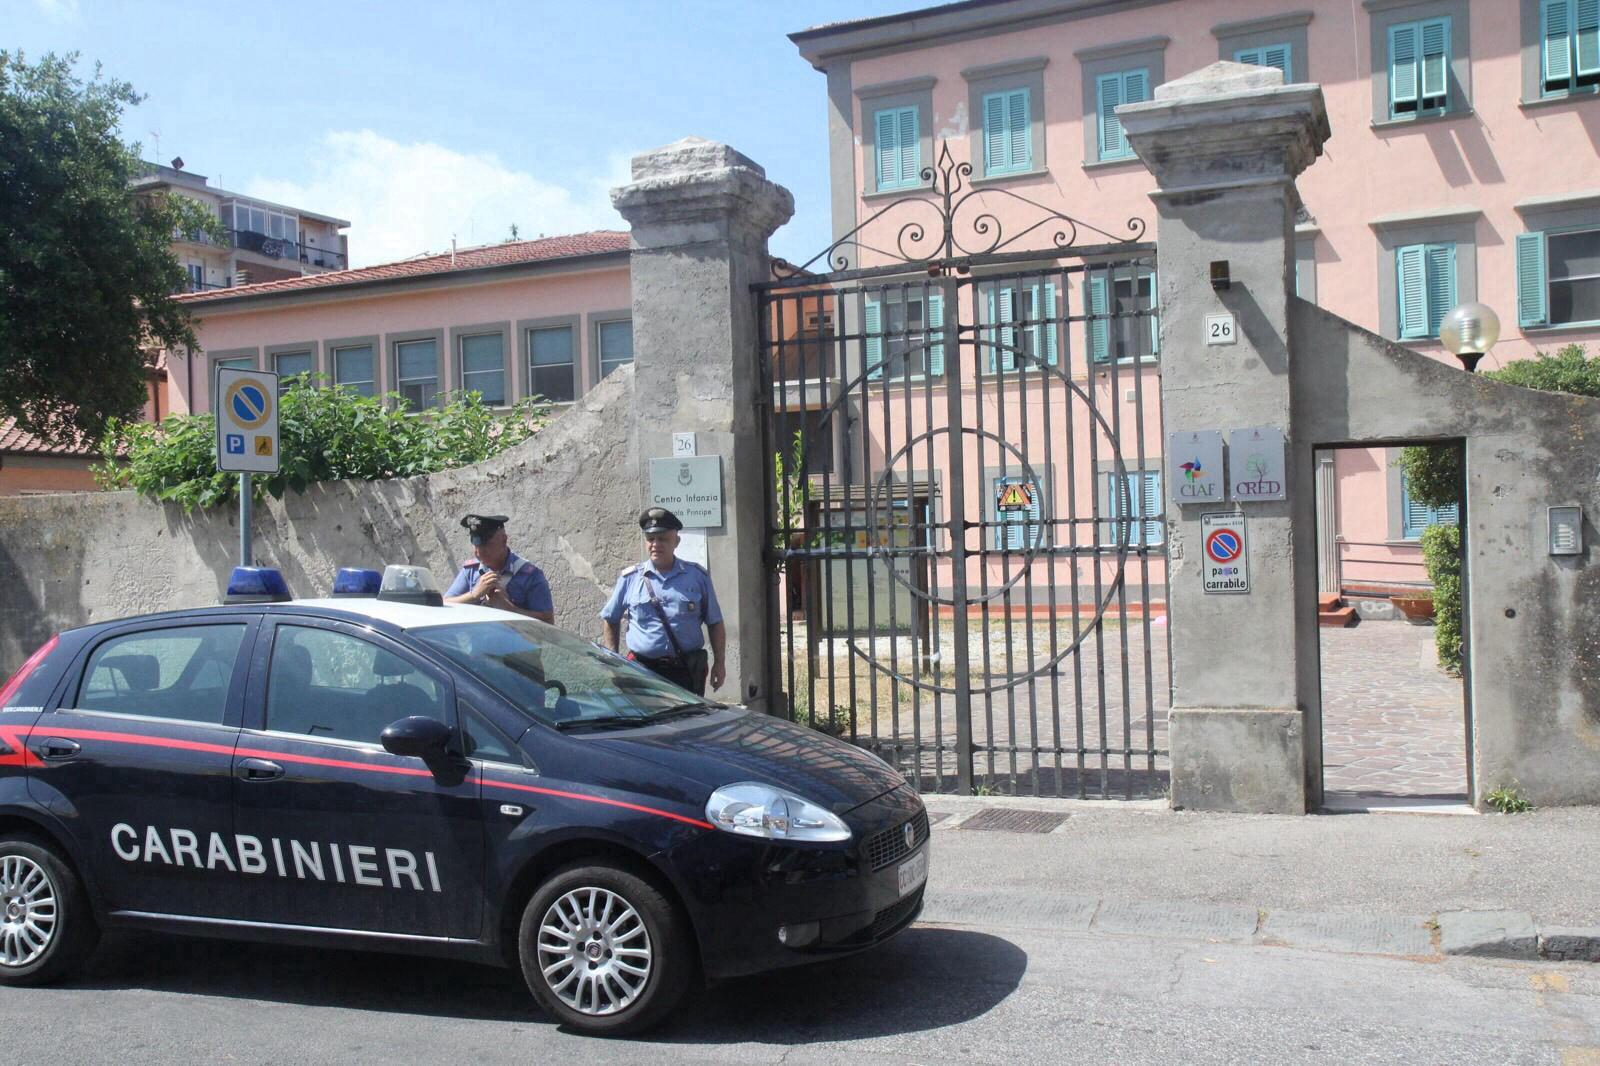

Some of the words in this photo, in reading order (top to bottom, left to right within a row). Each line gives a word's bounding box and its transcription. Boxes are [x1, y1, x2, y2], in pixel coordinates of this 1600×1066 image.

[1211, 321, 1231, 337] 26
[230, 437, 241, 452] P
[678, 439, 692, 451] 26
[1180, 483, 1215, 497] CIAF
[1236, 481, 1280, 494] CRED
[654, 494, 682, 504] Centro
[686, 492, 718, 503] Infanzia
[1212, 567, 1239, 577] paso
[1206, 577, 1246, 589] carrabile
[110, 822, 442, 893] CARABINIERI
